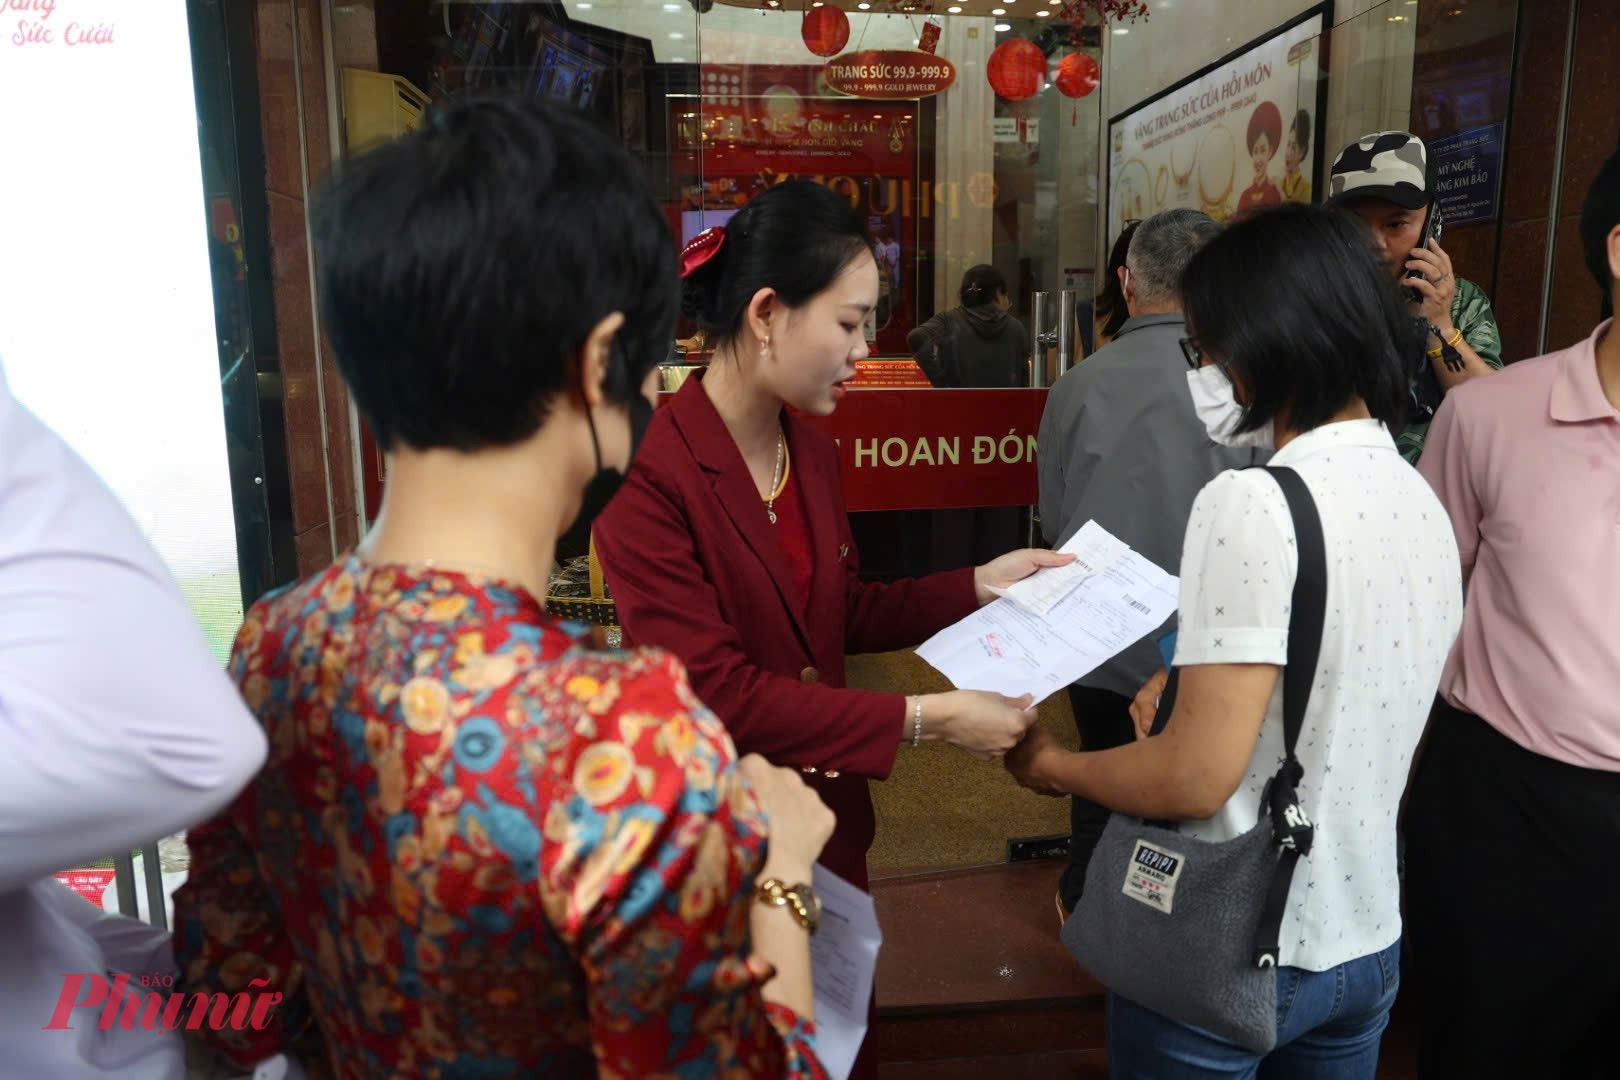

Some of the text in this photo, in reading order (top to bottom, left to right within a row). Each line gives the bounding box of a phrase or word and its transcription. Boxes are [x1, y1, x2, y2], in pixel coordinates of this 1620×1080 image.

[831, 65, 868, 79] TRANG
[869, 63, 892, 79] SỨC
[884, 83, 904, 92] GOLD
[905, 83, 937, 92] JEWELRY
[1222, 71, 1242, 100] HỒI
[1245, 63, 1272, 87] MÔN
[1452, 155, 1475, 171] NGHỆ
[1436, 179, 1453, 192] ÀNG
[1454, 174, 1470, 189] KIM
[855, 436, 960, 468] HOAN
[1138, 848, 1174, 873] REPIPI
